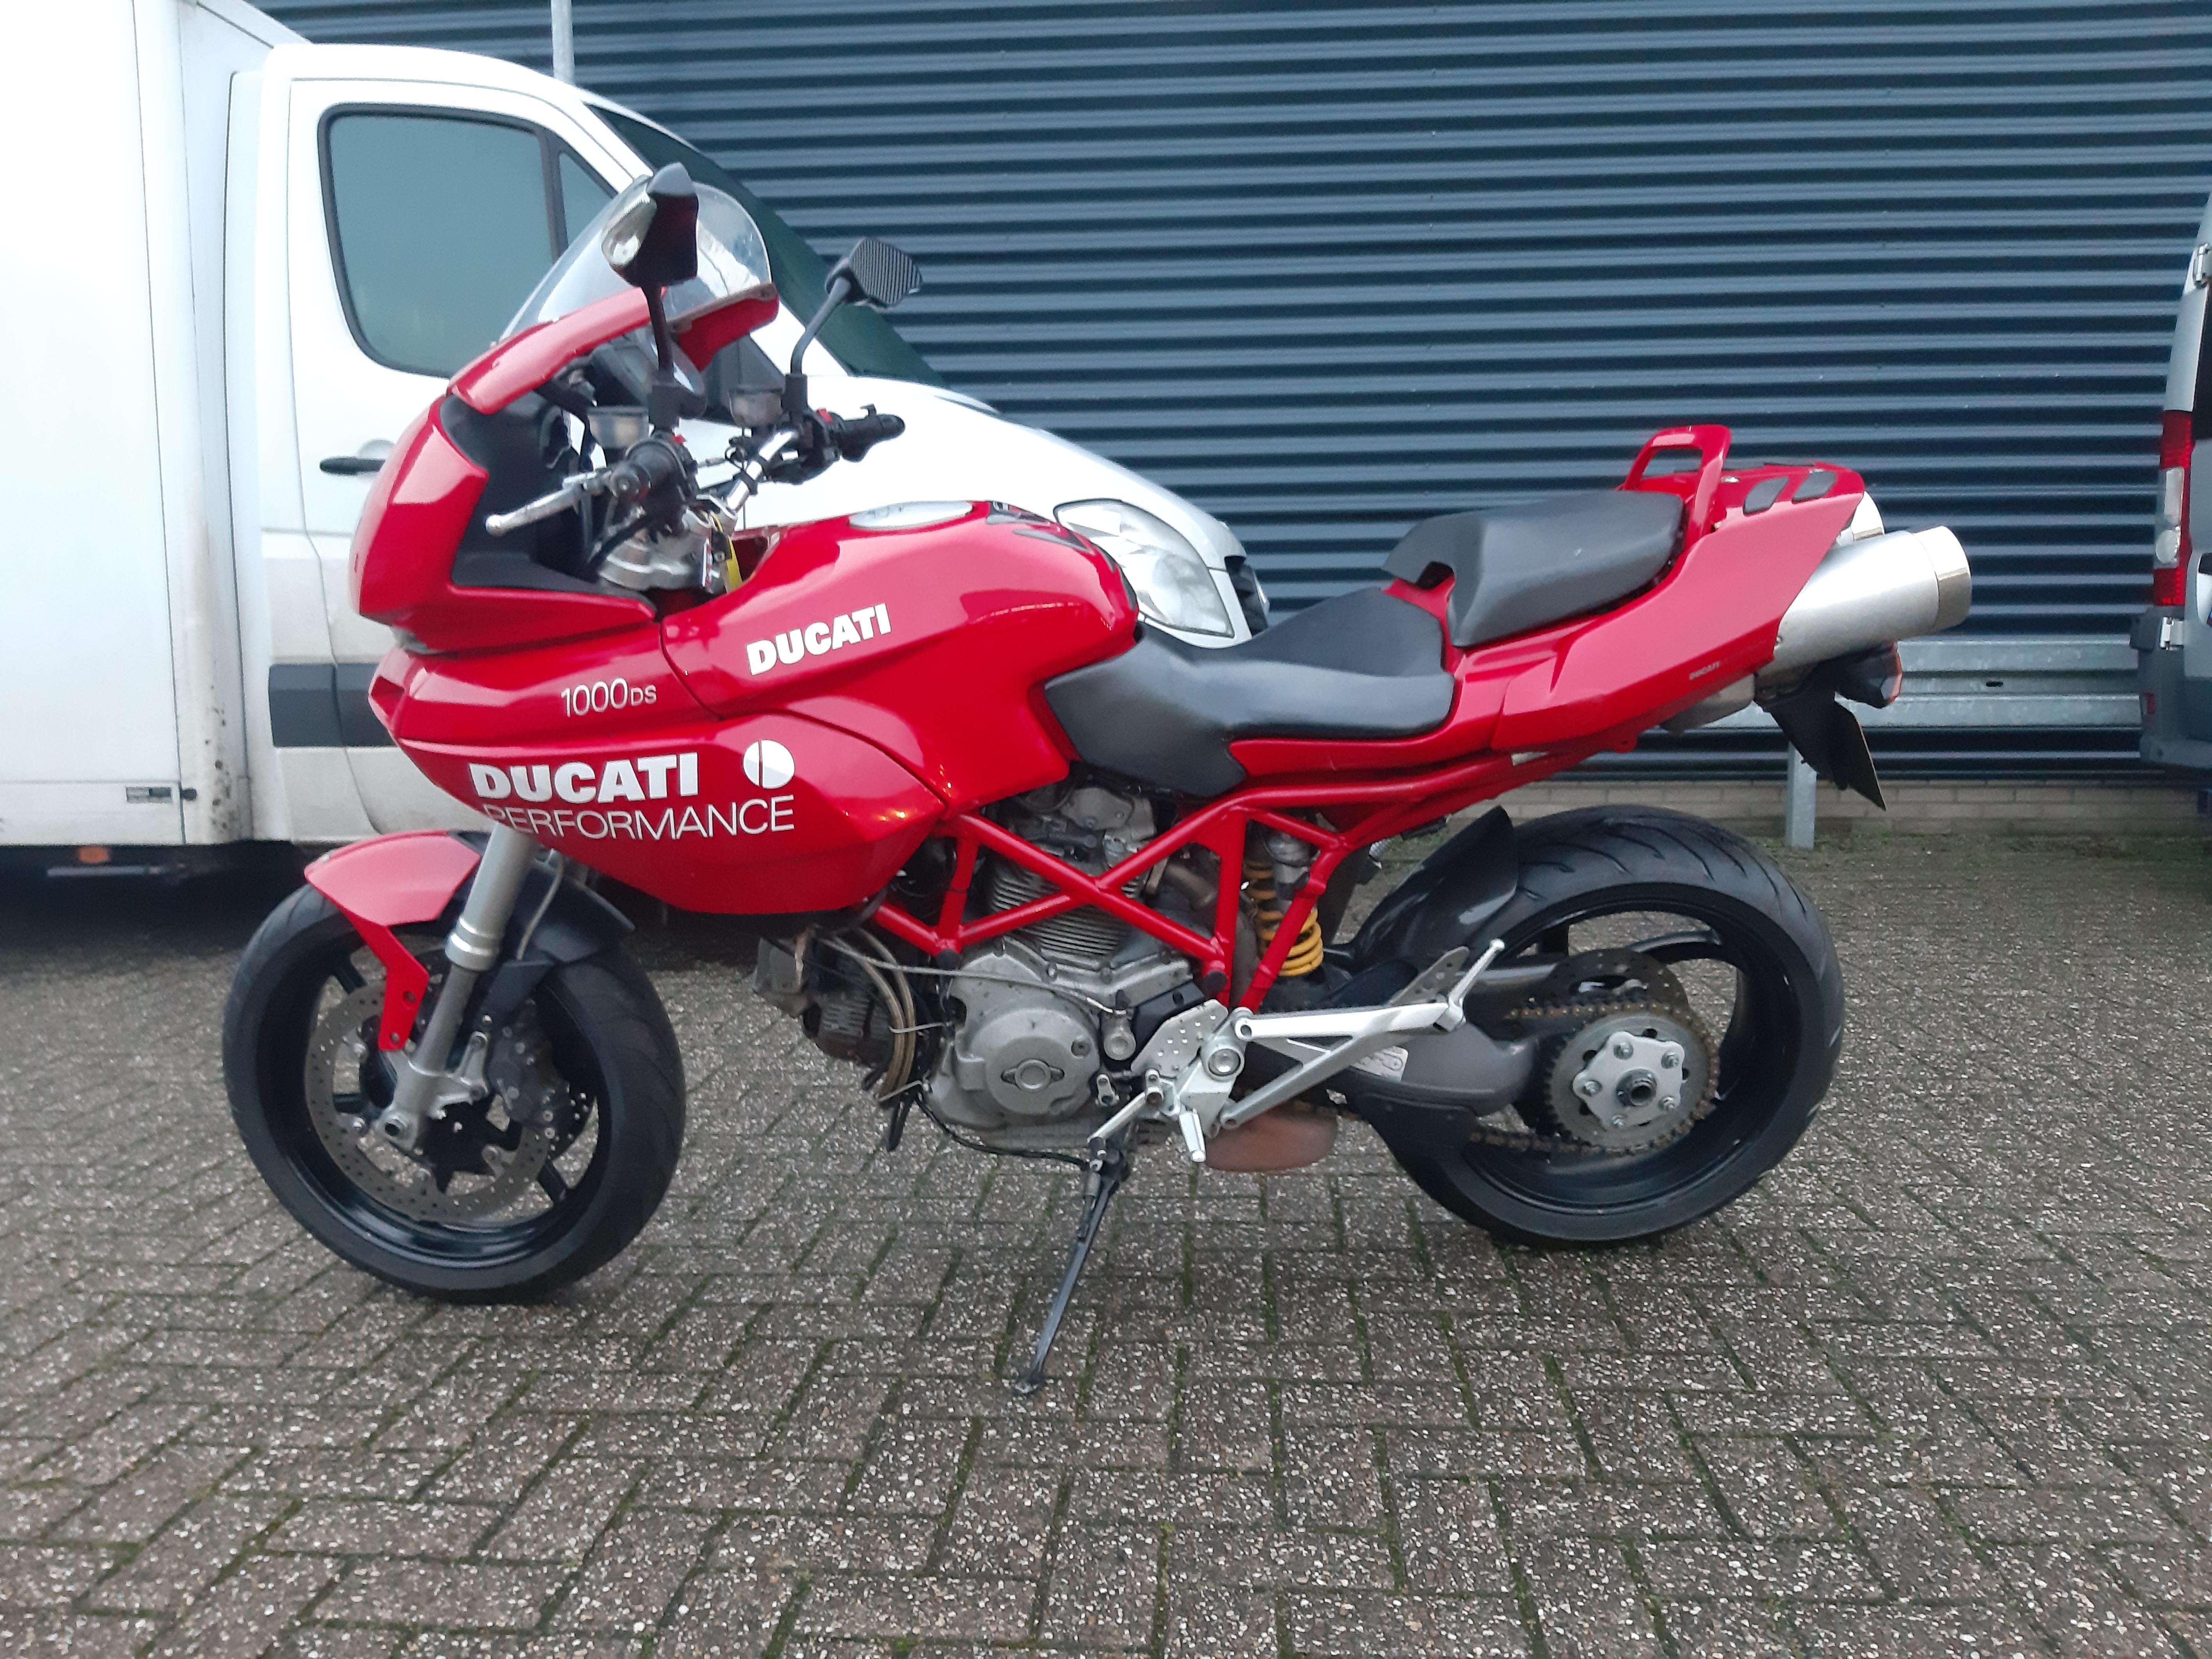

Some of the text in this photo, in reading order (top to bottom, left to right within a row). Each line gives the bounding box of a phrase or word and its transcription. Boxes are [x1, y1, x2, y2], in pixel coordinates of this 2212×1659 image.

[746, 603, 892, 676] DUCATI
[469, 752, 698, 804] DUCATI
[482, 794, 795, 840] PERFORMANCE
